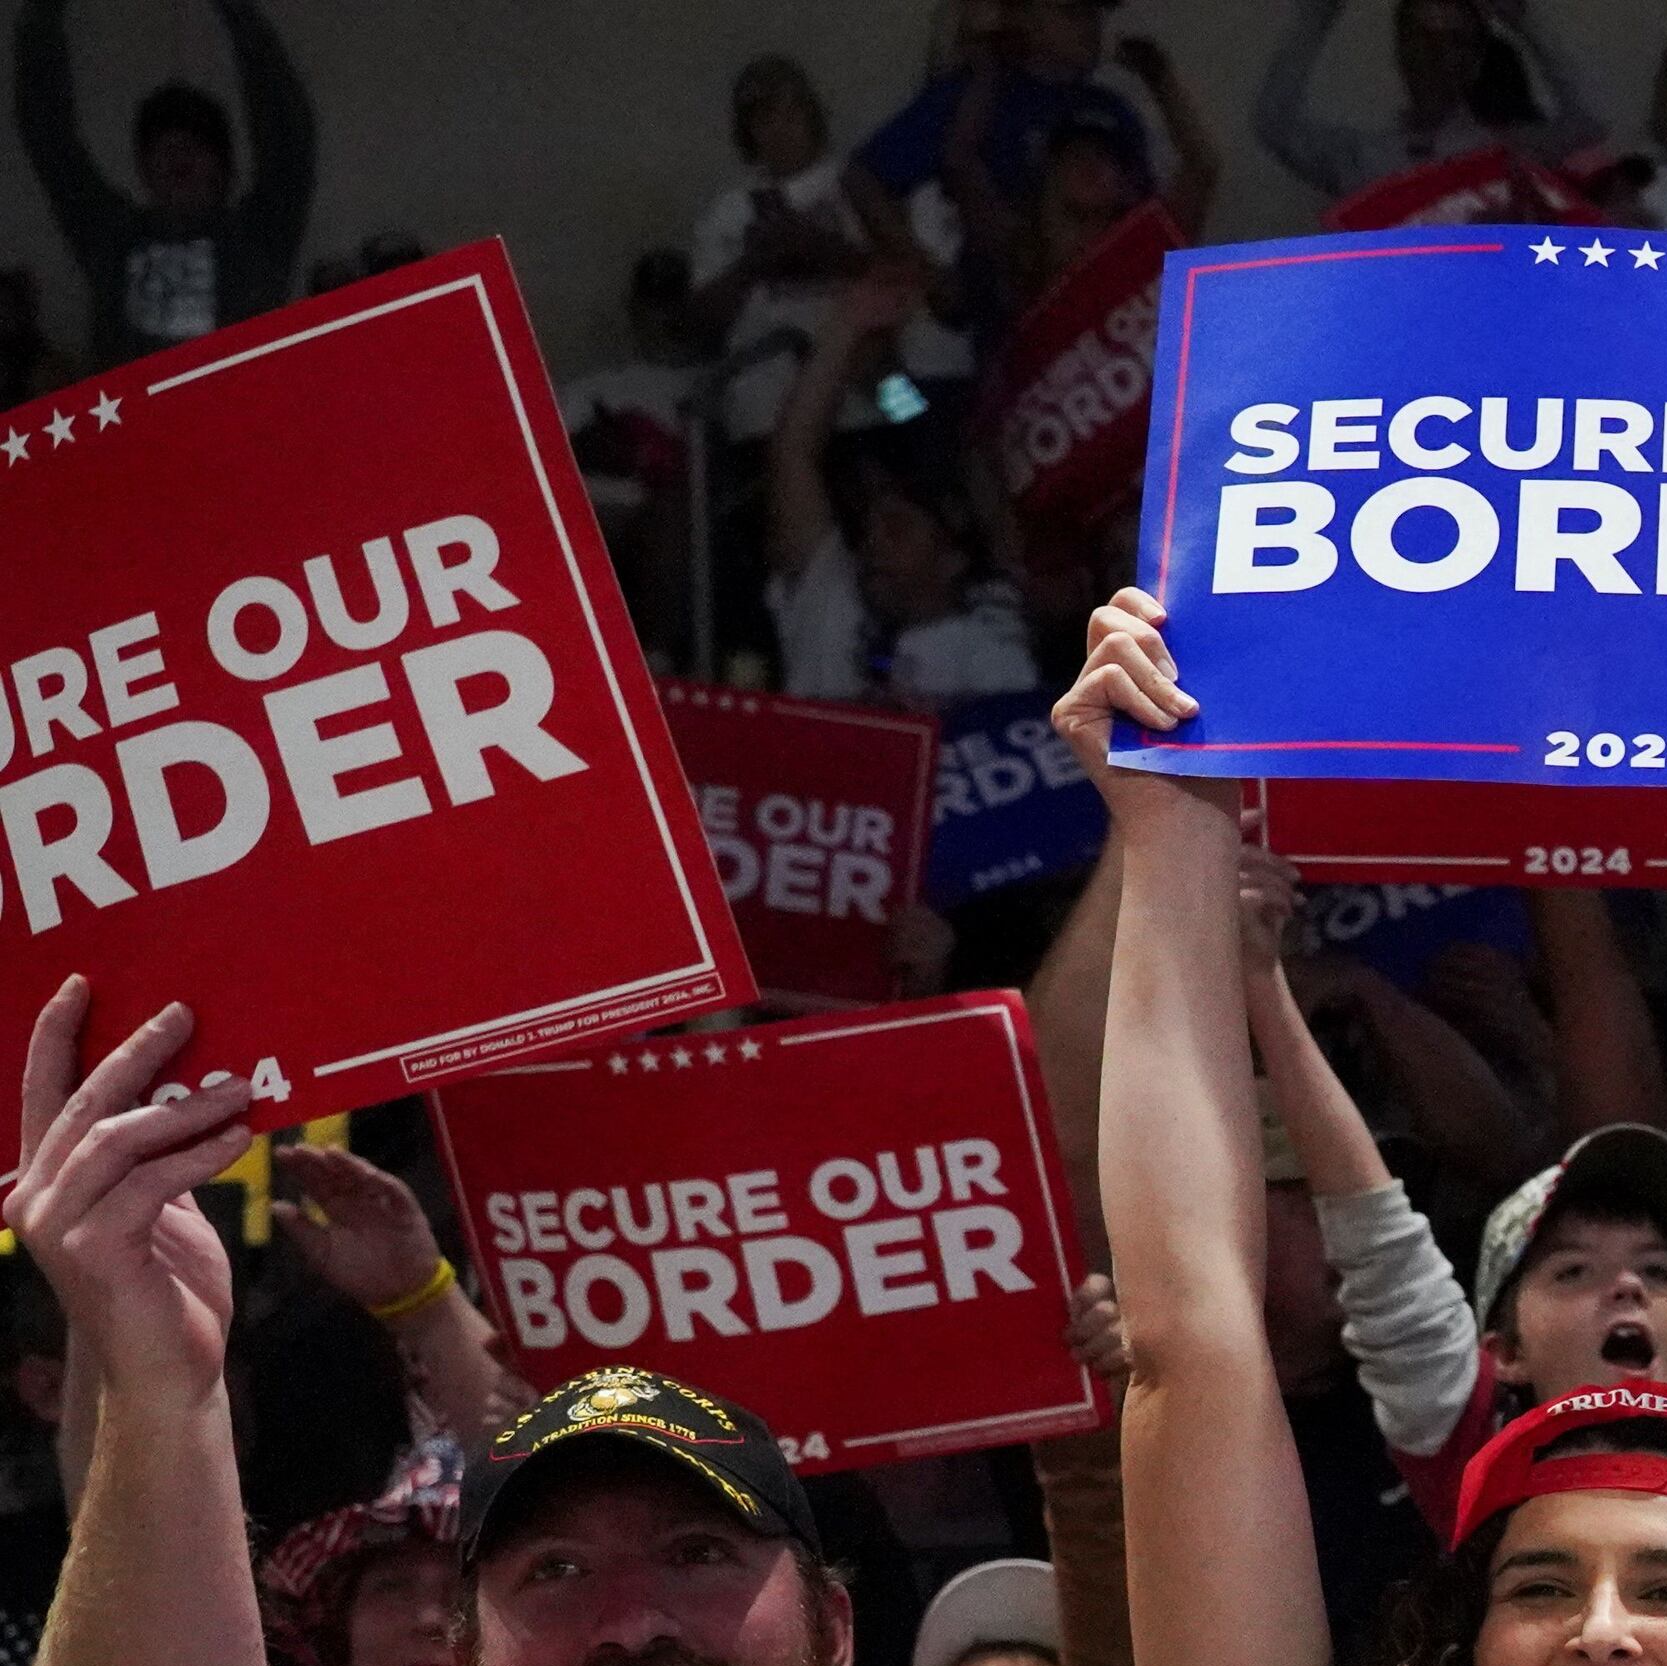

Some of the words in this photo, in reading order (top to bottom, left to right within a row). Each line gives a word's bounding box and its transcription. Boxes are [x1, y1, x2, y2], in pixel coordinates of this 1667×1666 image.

[0, 611, 180, 773] RE
[206, 513, 522, 682] OUR
[0, 629, 590, 936] RDER
[755, 792, 897, 855] OUR
[1523, 846, 1633, 877] 2024
[485, 1167, 791, 1255] SECURE
[807, 1136, 1008, 1221] OUR
[500, 1202, 1036, 1351] BORDER
